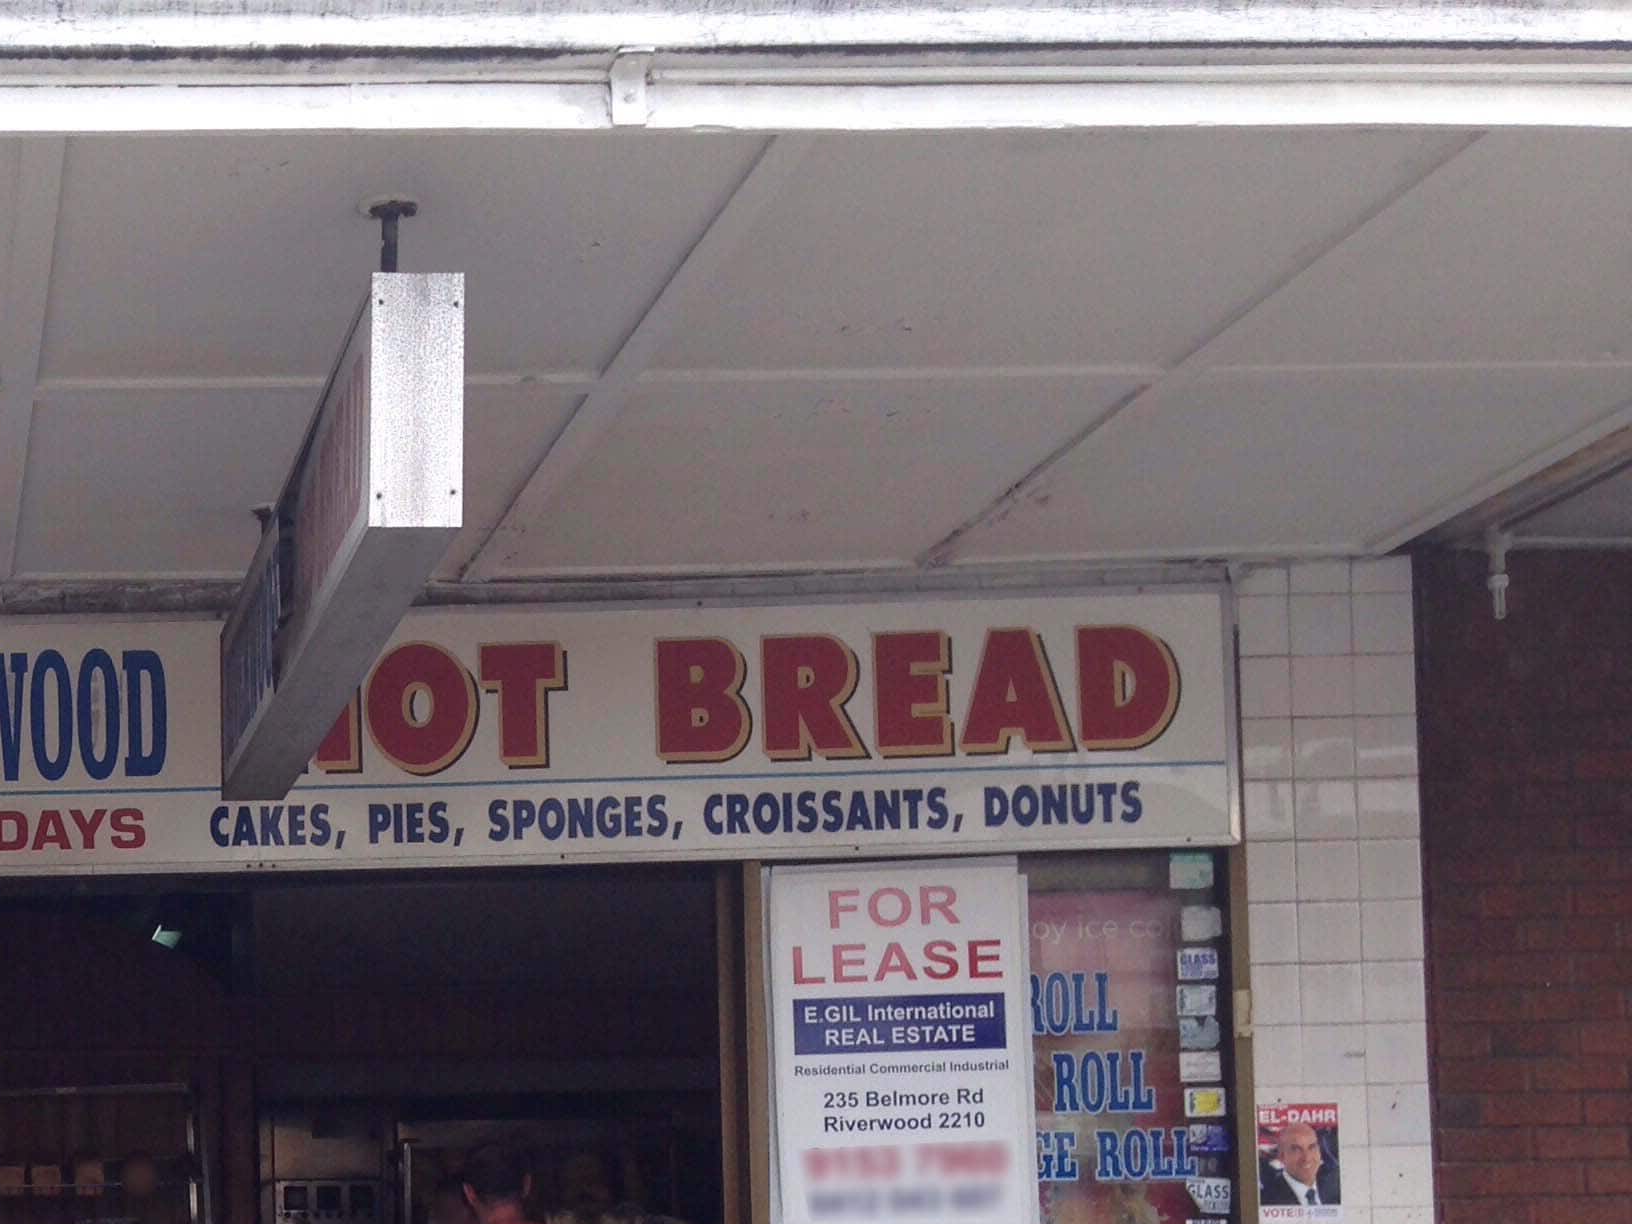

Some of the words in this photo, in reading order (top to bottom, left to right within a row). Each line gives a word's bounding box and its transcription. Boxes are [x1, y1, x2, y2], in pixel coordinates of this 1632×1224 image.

[303, 639, 568, 777] OT
[655, 624, 1181, 764] BREAD
[210, 803, 346, 850] CAKES,
[369, 801, 465, 847] PIES,
[488, 794, 683, 841] SPONGES,
[703, 787, 964, 836] CROISSANTS,
[984, 780, 1143, 826] DONUTS
[828, 885, 961, 929] FOR
[792, 939, 1004, 985] LEASE
[804, 1004, 862, 1024] E.GIL
[867, 1000, 996, 1022] International
[824, 1025, 885, 1046] REAL
[891, 1024, 977, 1045] ESTATE
[794, 1062, 866, 1078] Residential
[869, 1060, 947, 1076] Commercial
[949, 1058, 1010, 1073] Industrial
[1053, 1050, 1156, 1115] ROLL
[823, 1091, 859, 1109] 235
[866, 1089, 950, 1108] Belmore
[956, 1088, 984, 1106] Rd
[823, 1113, 933, 1134] Riverwood
[938, 1111, 986, 1130] 2210
[1258, 1108, 1337, 1124] EL-DAHR
[1095, 1127, 1199, 1183] ROLL
